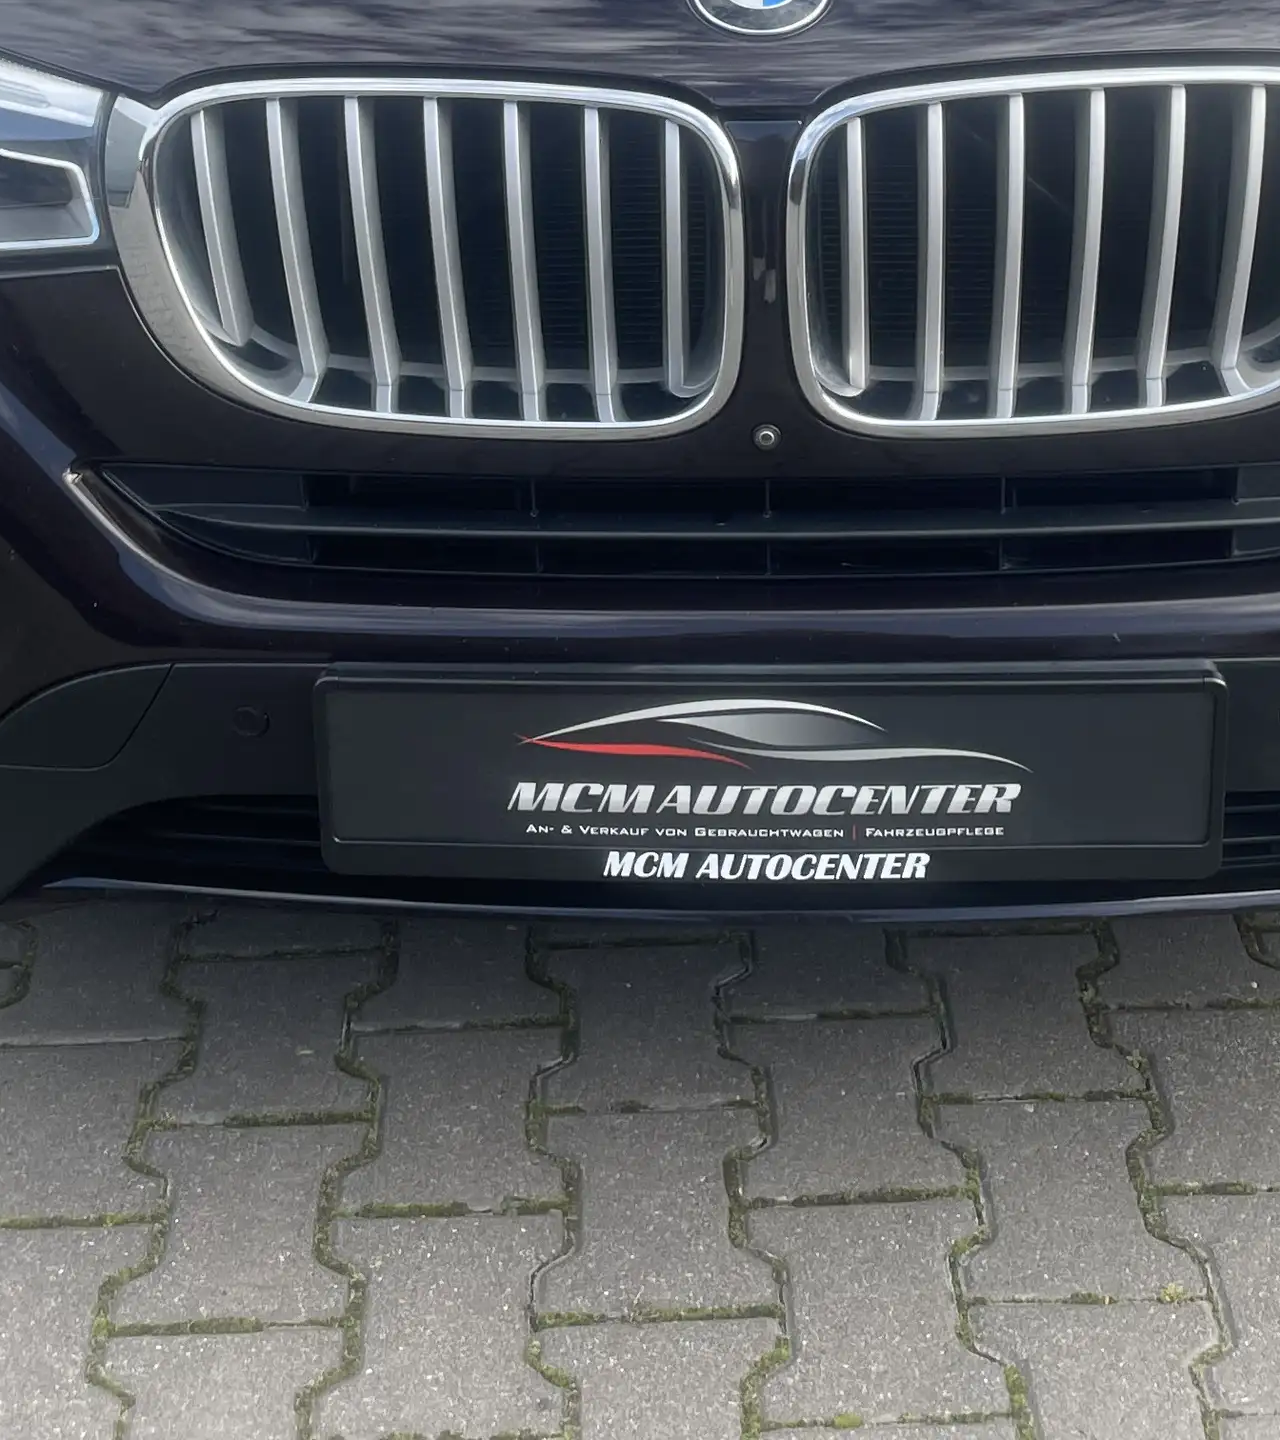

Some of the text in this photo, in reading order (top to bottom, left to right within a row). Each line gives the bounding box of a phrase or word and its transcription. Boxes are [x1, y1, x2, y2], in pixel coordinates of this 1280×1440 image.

[507, 782, 1022, 815] MCM AUTOCENTER
[560, 824, 573, 835] &
[603, 850, 931, 880] MCM AUTOCENTER
